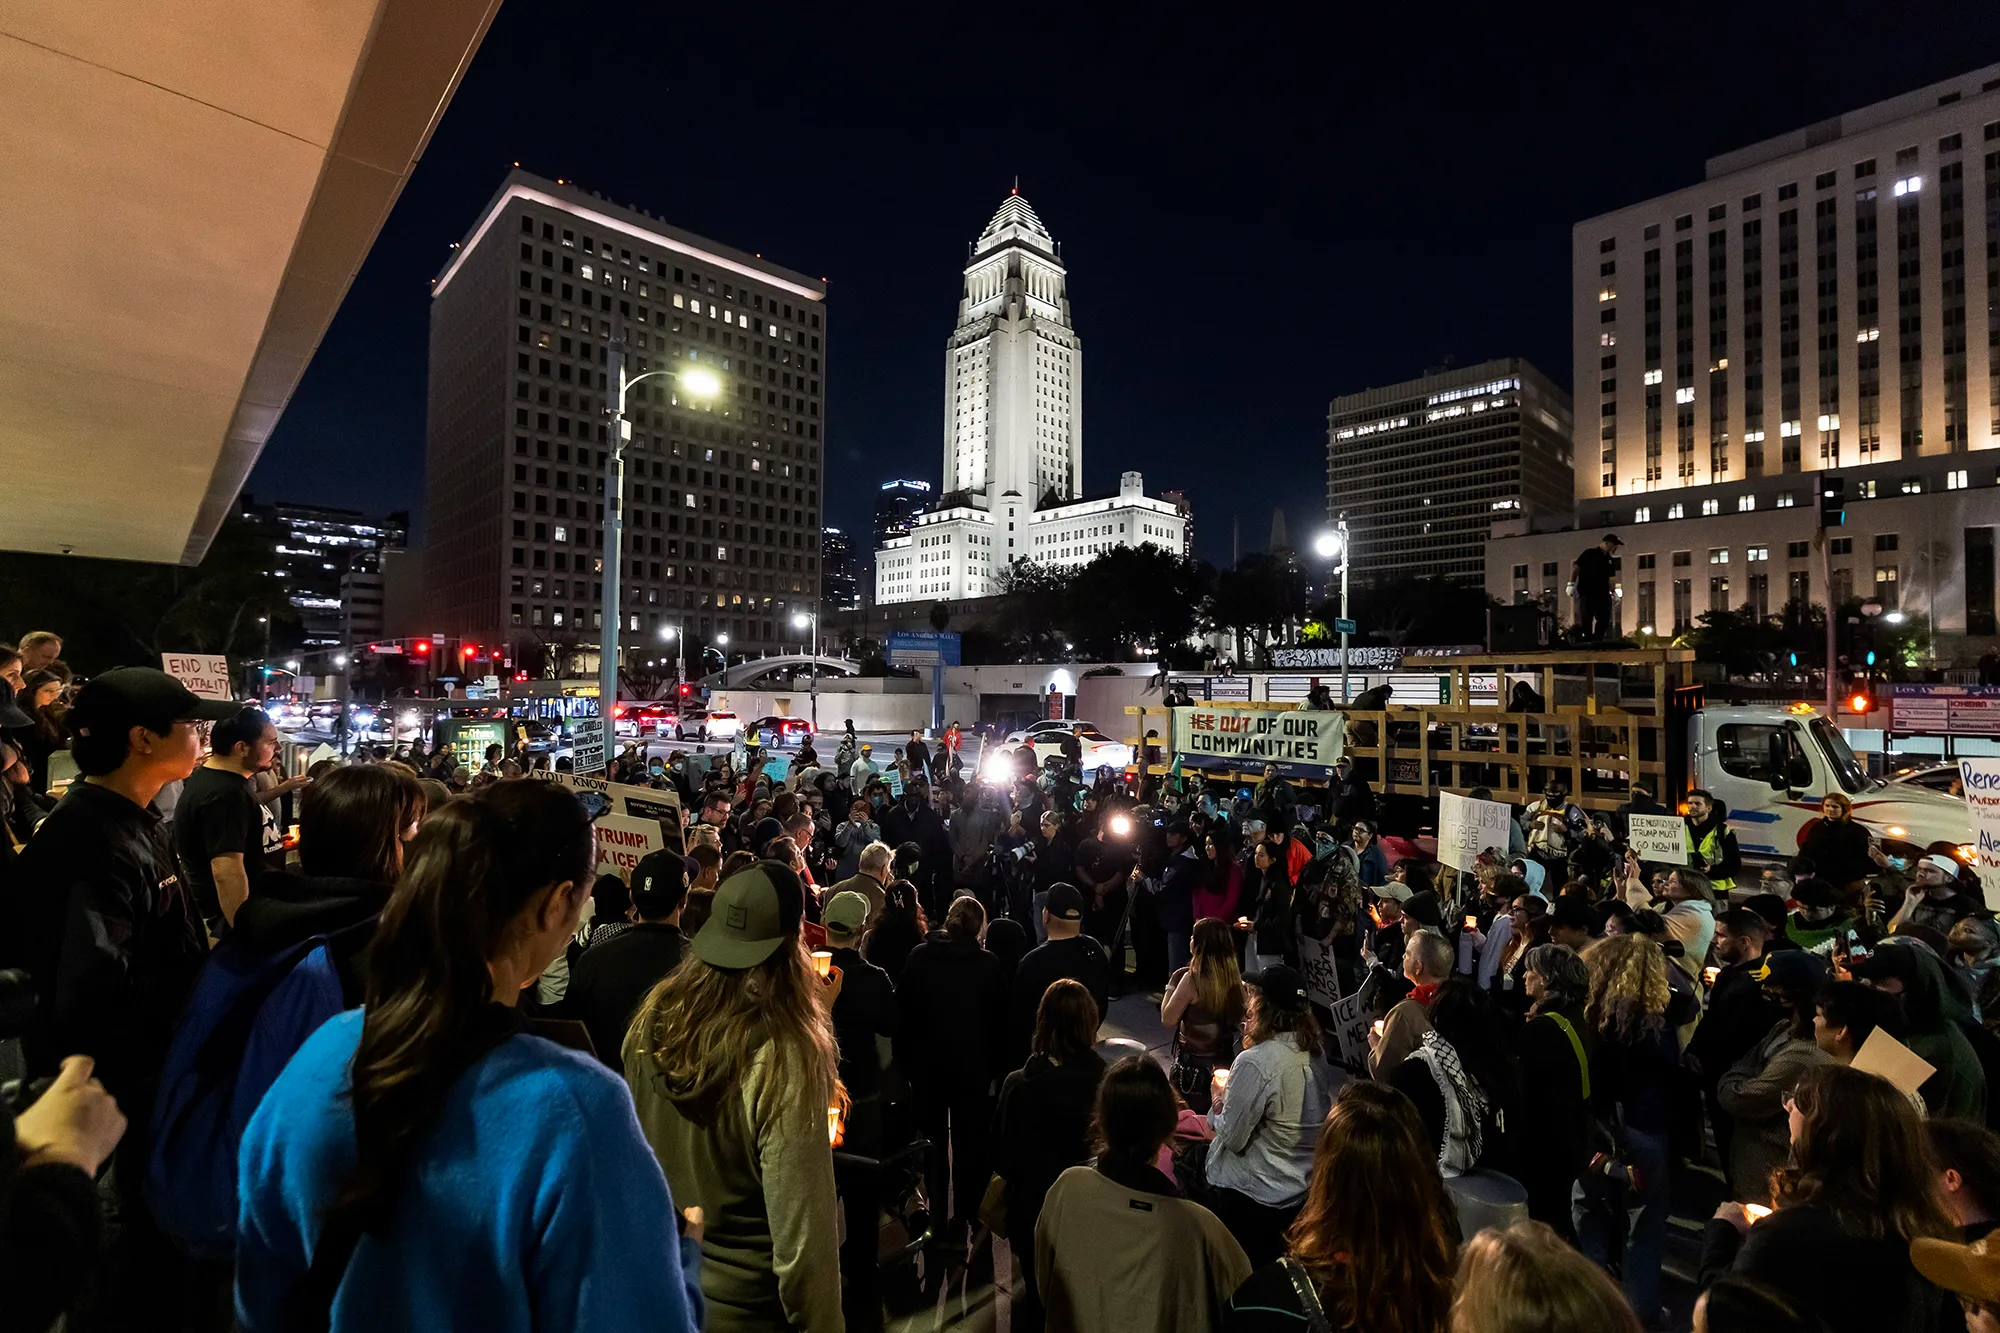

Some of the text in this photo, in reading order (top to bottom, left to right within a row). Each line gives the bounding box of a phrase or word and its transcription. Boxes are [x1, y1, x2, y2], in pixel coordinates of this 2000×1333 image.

[169, 658, 229, 675] END ICE
[575, 724, 584, 734] LOS
[1191, 713, 1318, 737] ICE OUT OF OUR
[575, 745, 603, 757] STOP
[1191, 733, 1318, 760] COMMUNITIES
[575, 757, 584, 768] ICE
[537, 770, 609, 792] YOU KNOW
[1442, 798, 1510, 831] ABOLISH
[1631, 817, 1645, 827] ICE
[597, 827, 649, 850] TRUMP!
[1451, 824, 1478, 850] ICE
[1632, 828, 1677, 838] TRUMP MUST
[1636, 840, 1649, 849] GO
[1334, 1000, 1357, 1026] ICE
